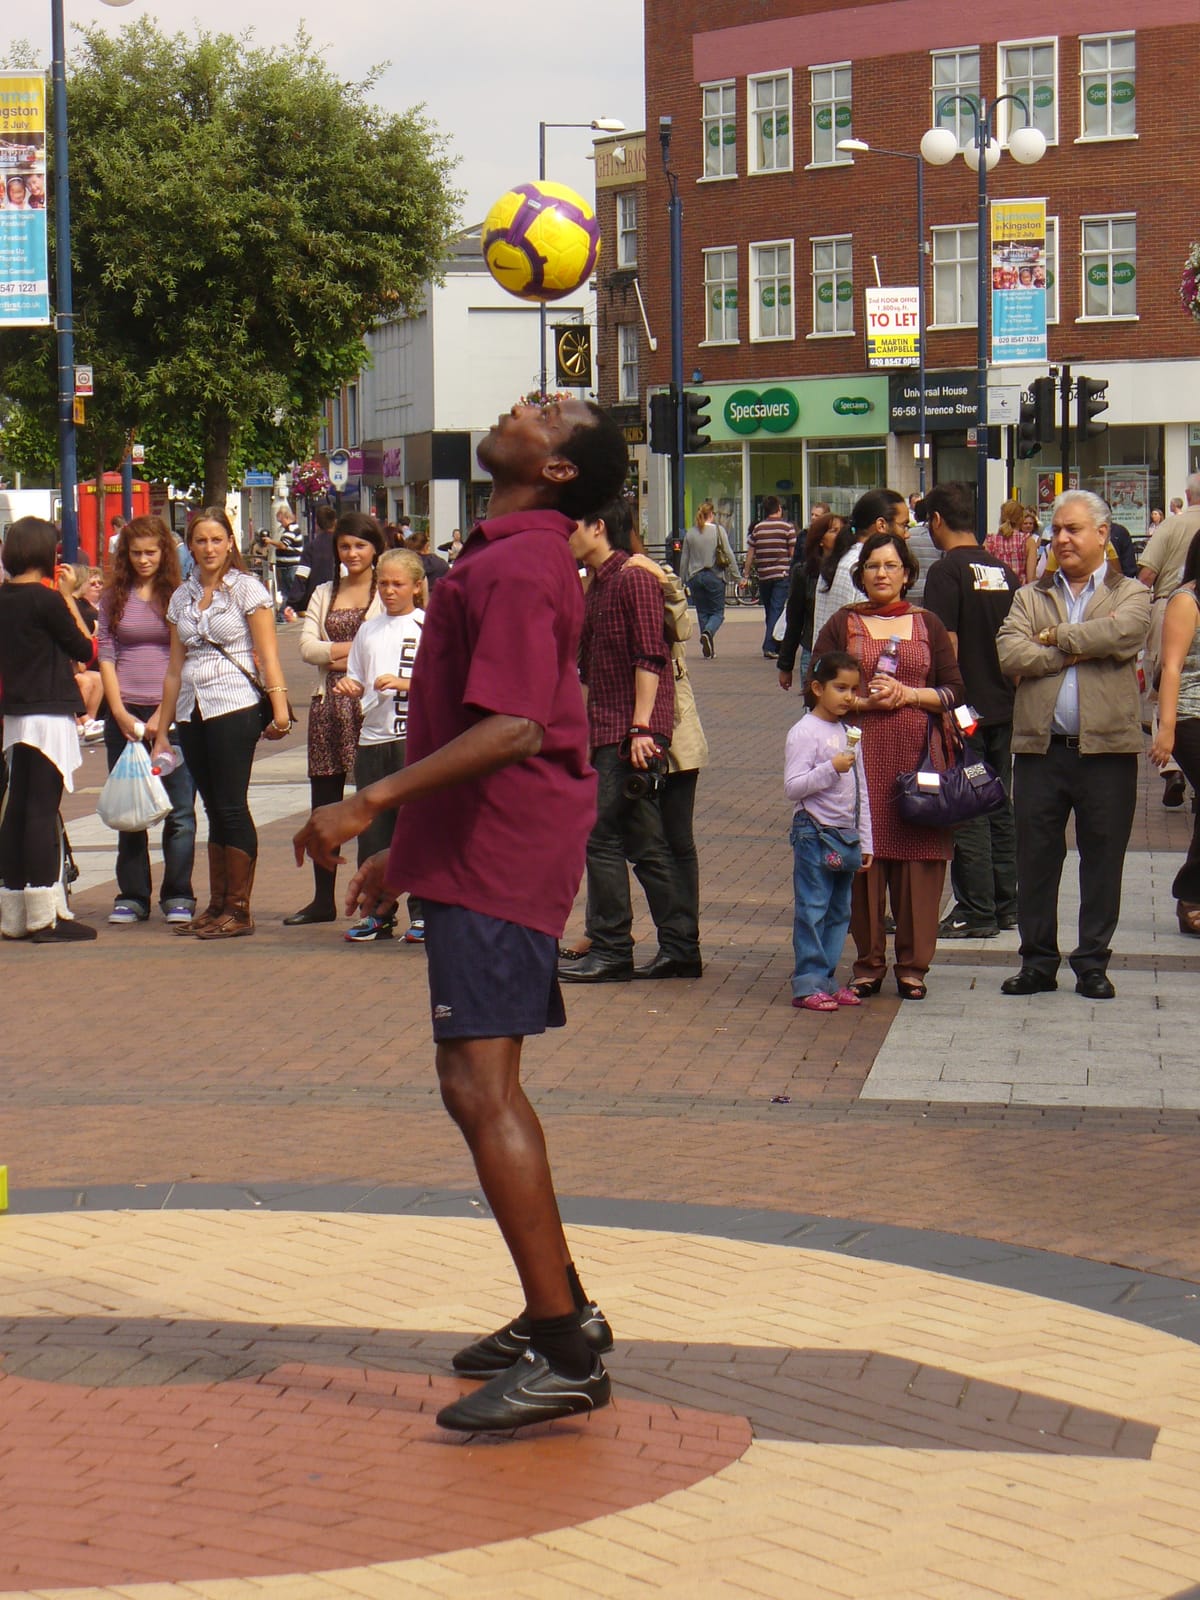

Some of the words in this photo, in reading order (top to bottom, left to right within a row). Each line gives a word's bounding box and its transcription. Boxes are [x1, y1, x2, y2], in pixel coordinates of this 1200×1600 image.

[0, 106, 39, 119] gston
[3, 120, 9, 129] 2
[11, 120, 30, 129] July
[1003, 222, 1041, 231] Kingston
[18, 283, 37, 292] 1221
[869, 313, 890, 328] TO
[895, 312, 918, 327] LET
[881, 338, 908, 346] MARTIN
[876, 345, 914, 354] CAMPBELL
[870, 358, 883, 366] 020
[942, 385, 968, 396] House
[840, 401, 869, 410] Specsavers
[892, 405, 917, 417] 56-58
[918, 405, 954, 416] larence
[955, 403, 978, 414] Stree
[730, 402, 790, 422] Specsavers
